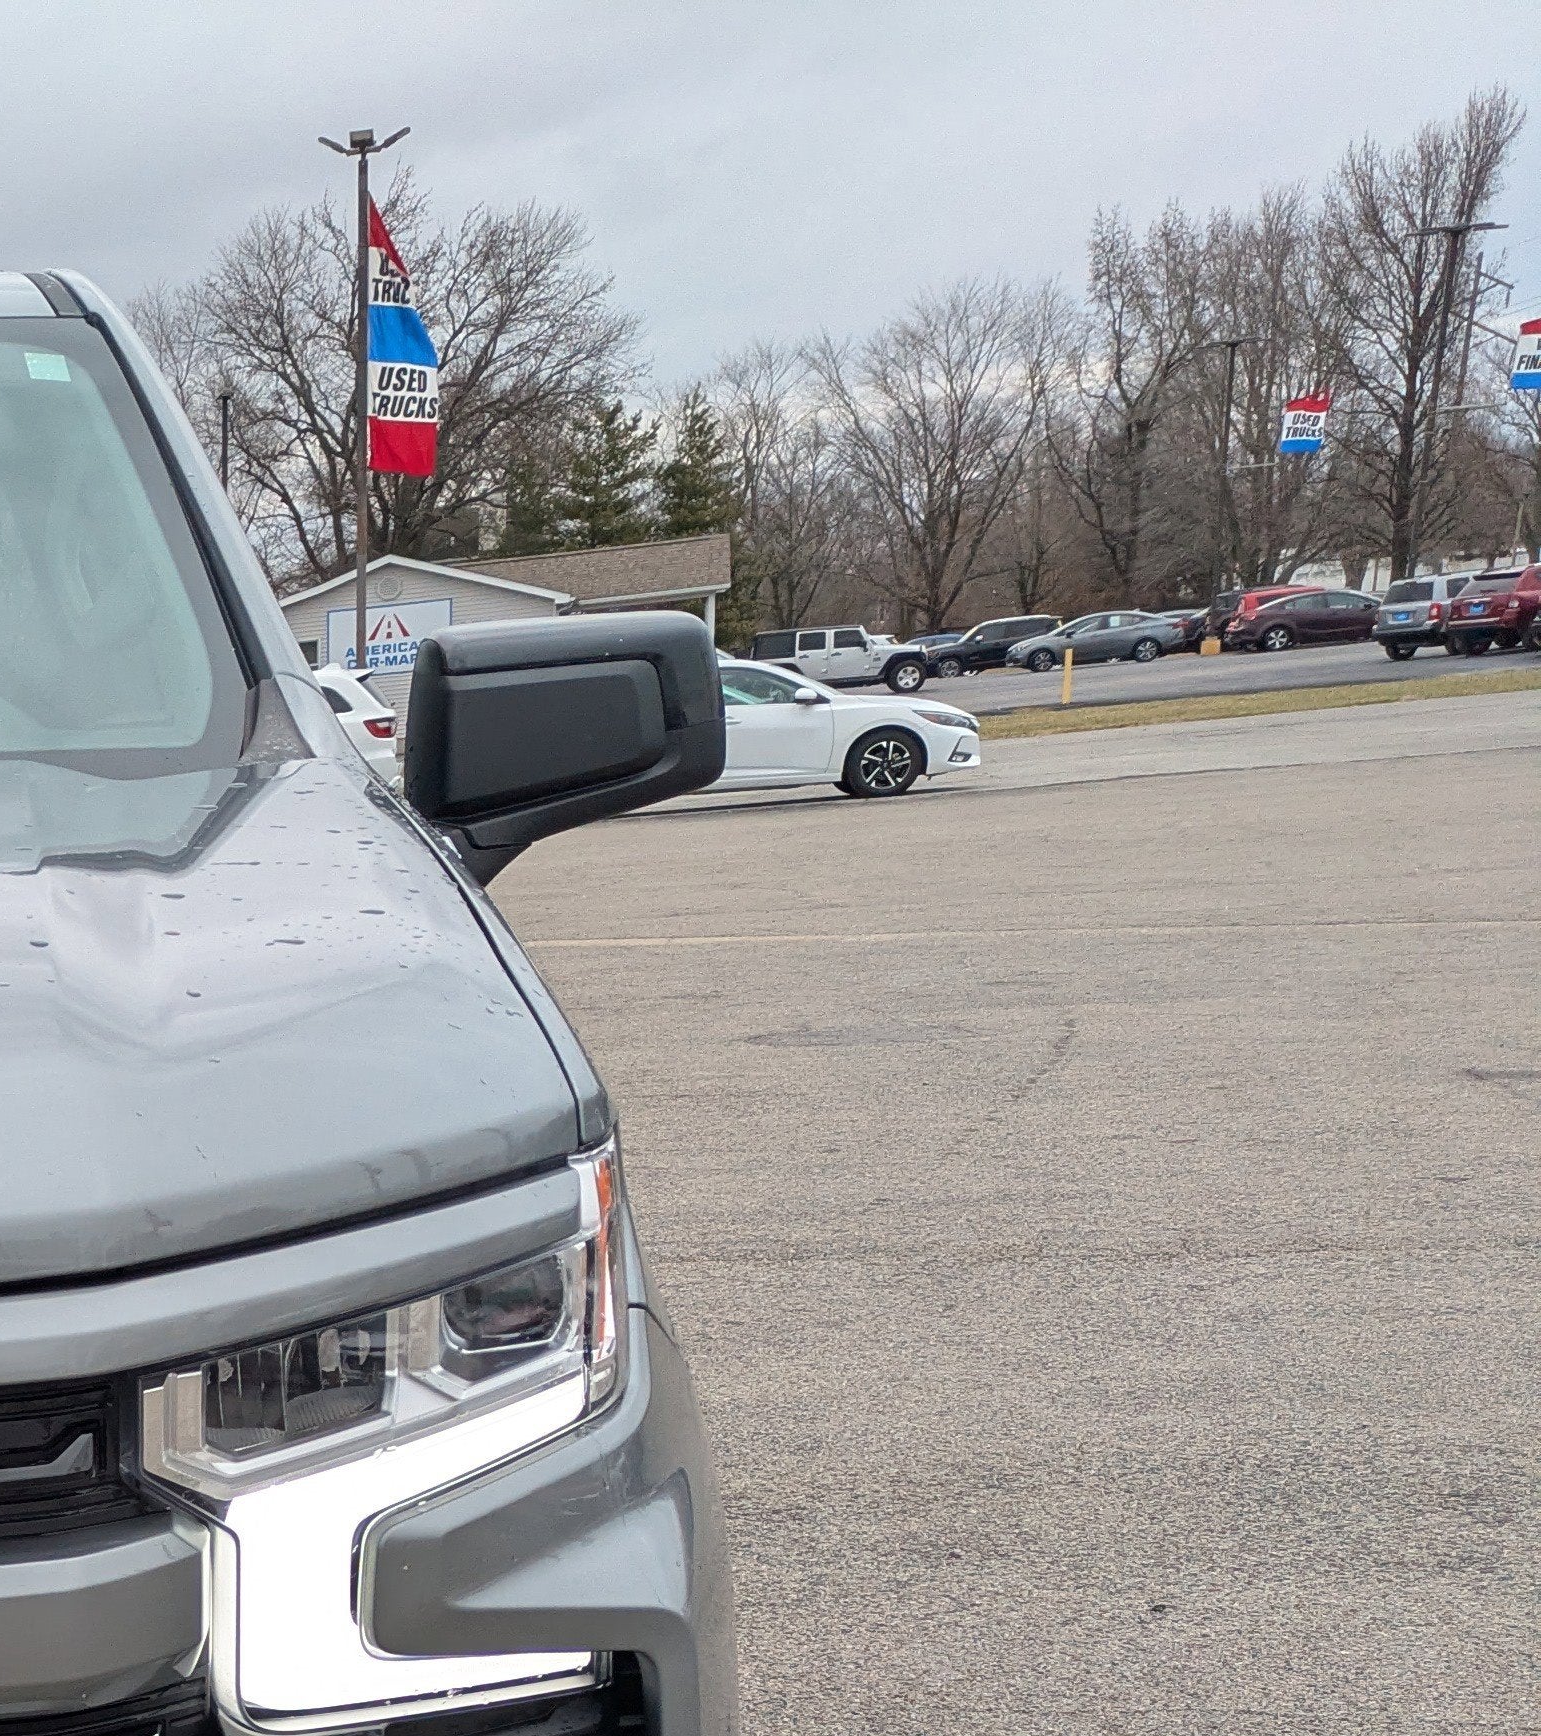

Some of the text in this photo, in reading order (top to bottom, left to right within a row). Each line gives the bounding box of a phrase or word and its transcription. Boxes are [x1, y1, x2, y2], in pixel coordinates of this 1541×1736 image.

[377, 366, 428, 393] USED
[371, 393, 438, 419] TRUCKS
[1291, 412, 1321, 427] USED
[1285, 426, 1324, 439] TRUCKS
